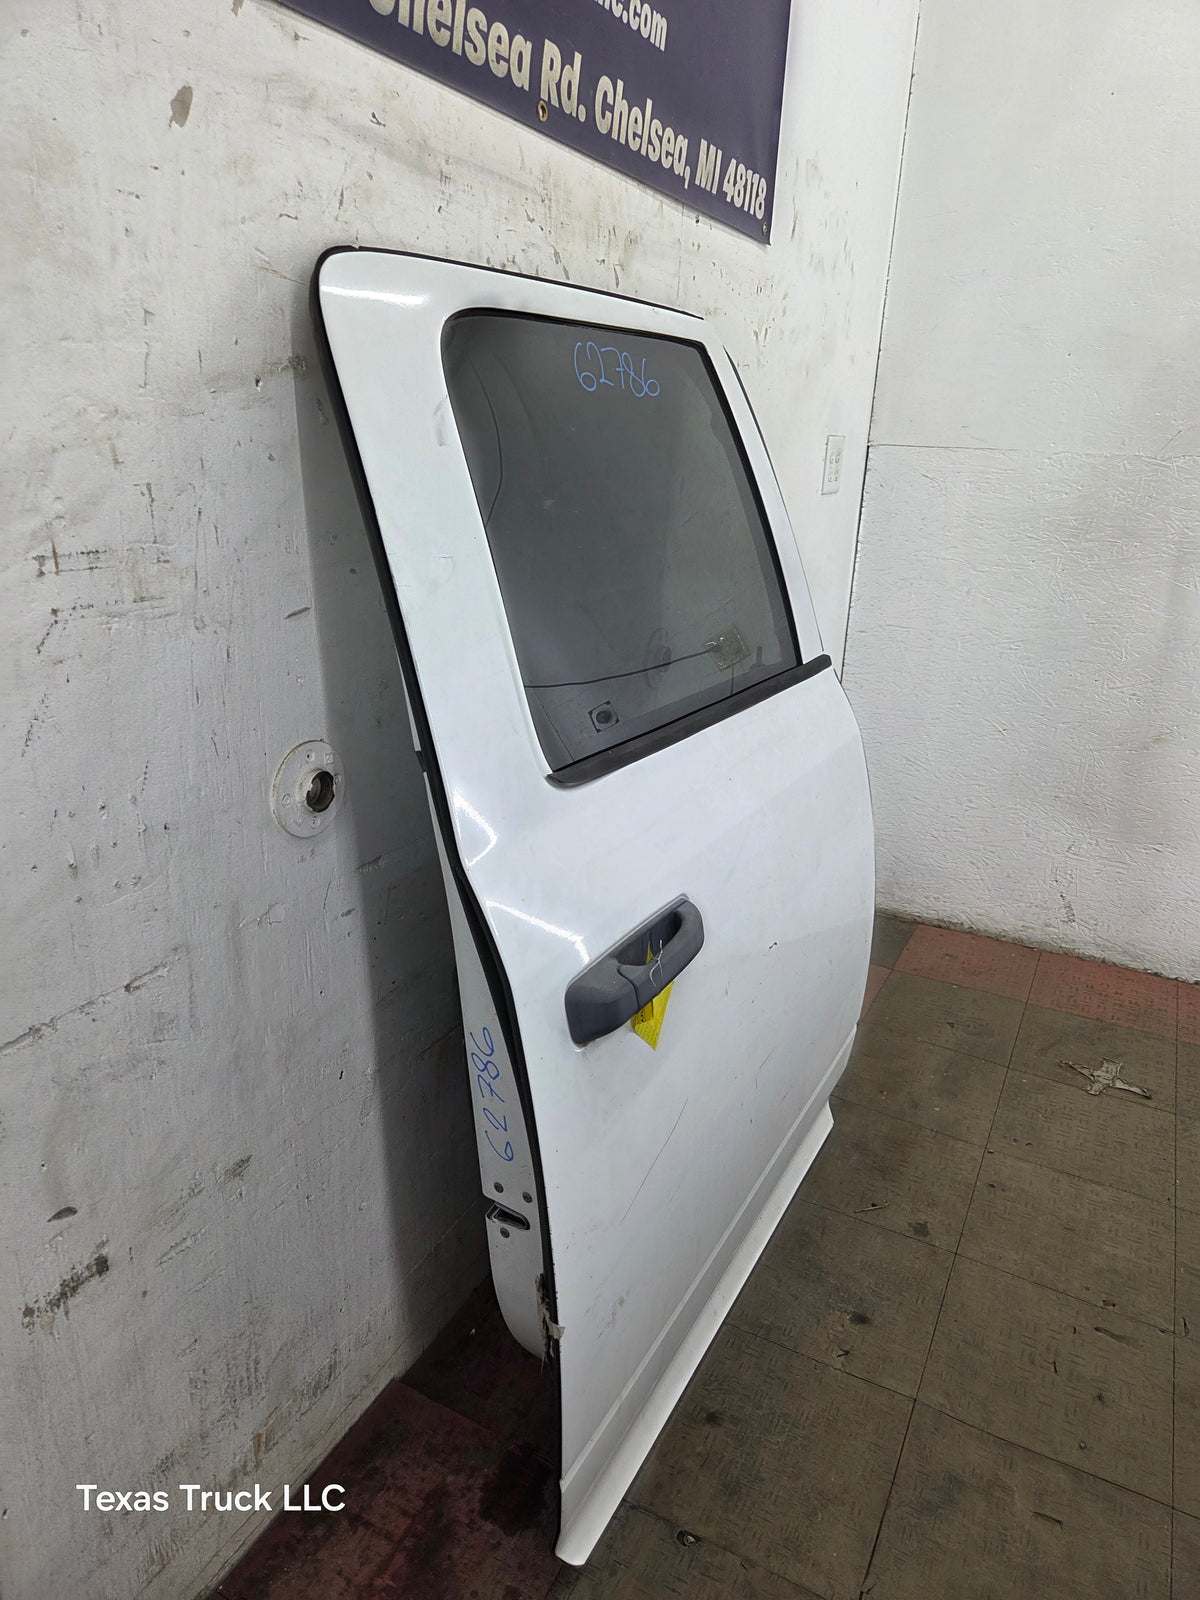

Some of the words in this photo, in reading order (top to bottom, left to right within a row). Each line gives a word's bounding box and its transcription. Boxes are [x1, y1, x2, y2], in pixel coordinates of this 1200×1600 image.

[369, 0, 532, 91] elsea
[541, 39, 586, 122] Rd.
[595, 75, 690, 190] Chelsea,
[695, 138, 722, 195] MI
[723, 158, 767, 220] 48118
[574, 341, 660, 397] 62786
[470, 1027, 514, 1162] 62786
